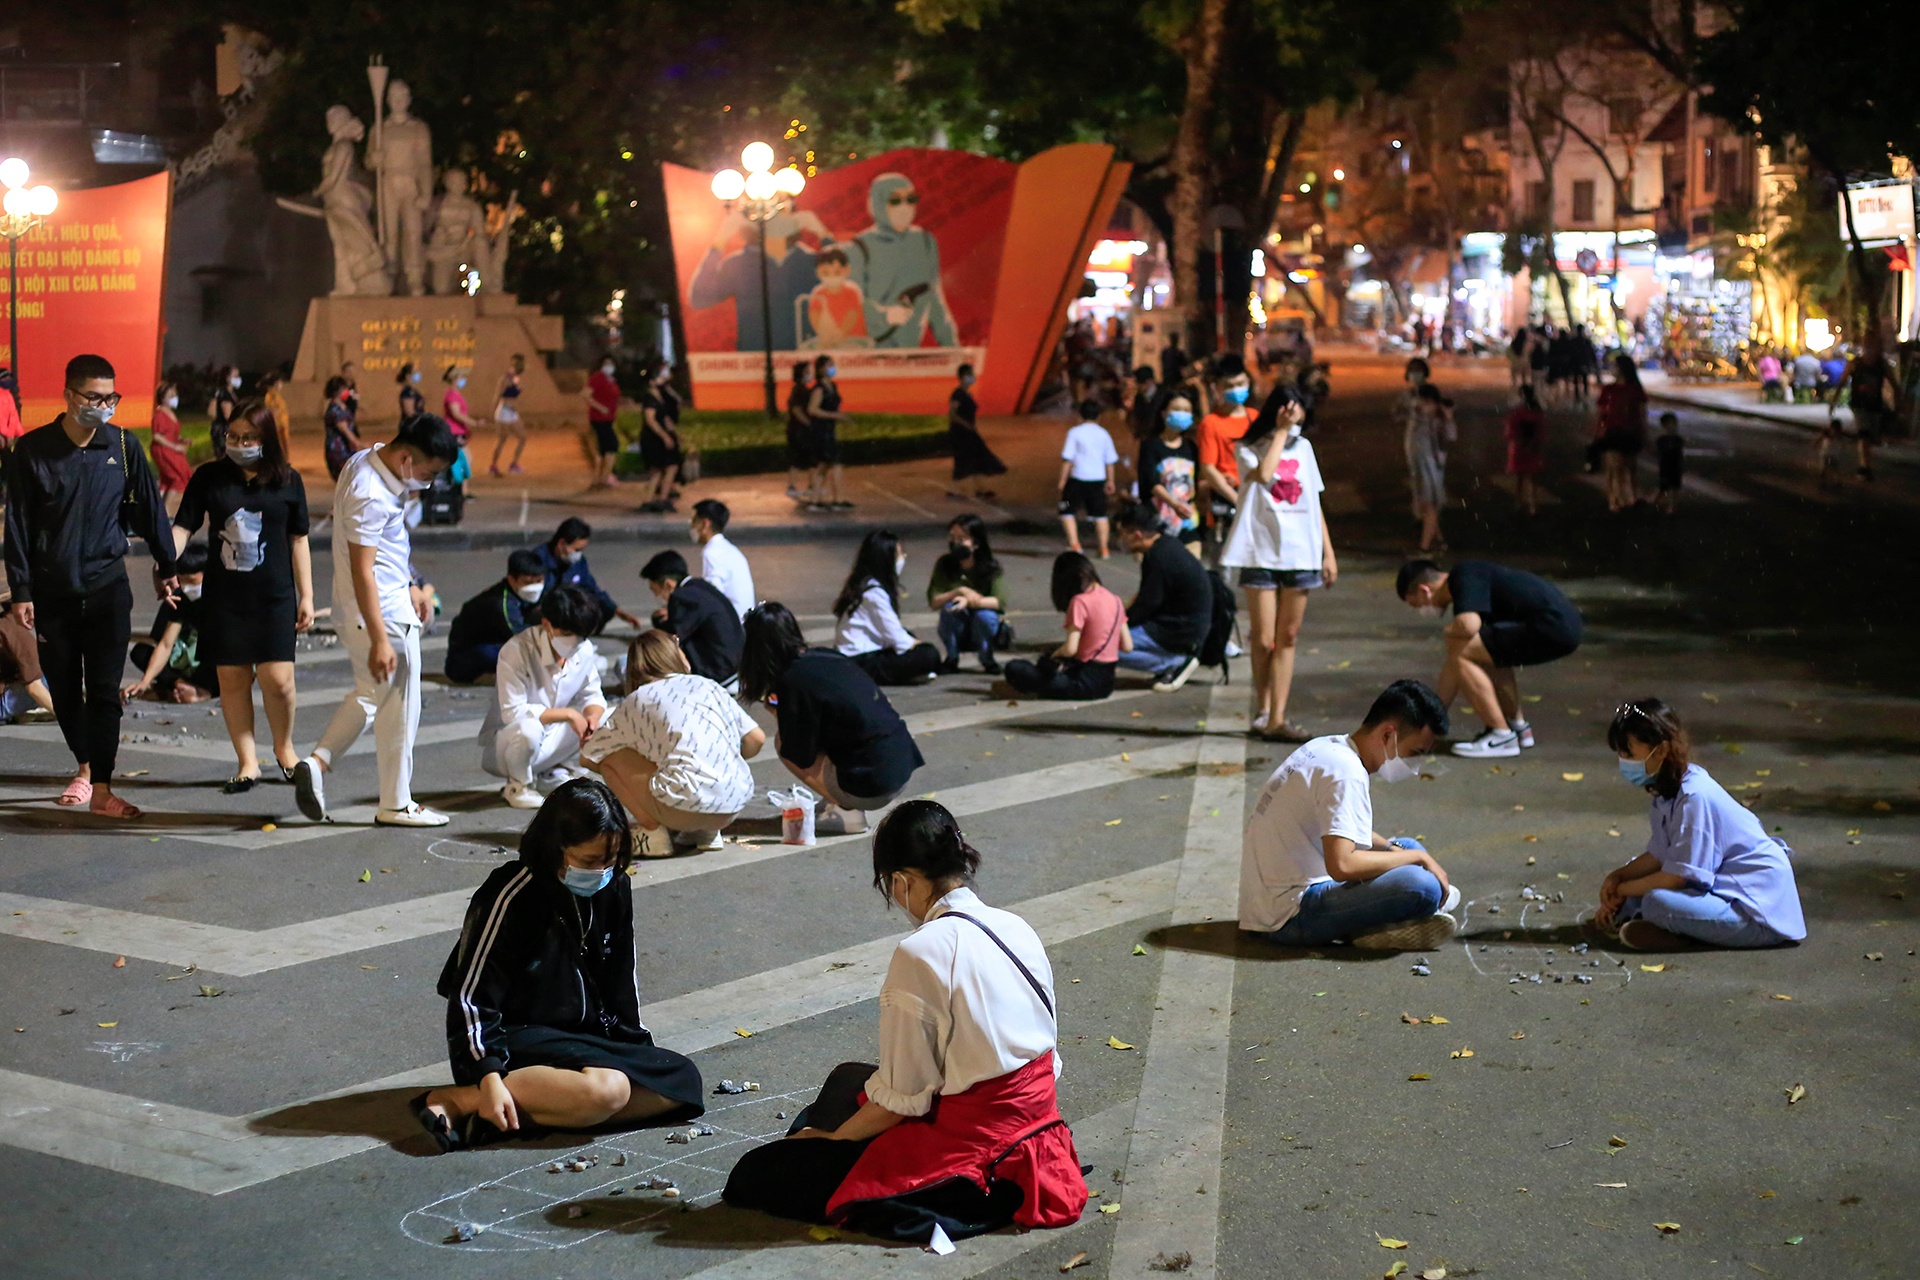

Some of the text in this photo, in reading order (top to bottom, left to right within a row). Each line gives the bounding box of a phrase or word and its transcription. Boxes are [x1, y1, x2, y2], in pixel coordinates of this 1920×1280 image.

[61, 221, 90, 244] HIỆU
[0, 241, 141, 271] UẾT ĐẠI HỘI ĐẢNG BỘ
[0, 267, 136, 296] ĐI HỘI XIII CỦA ĐẢNG
